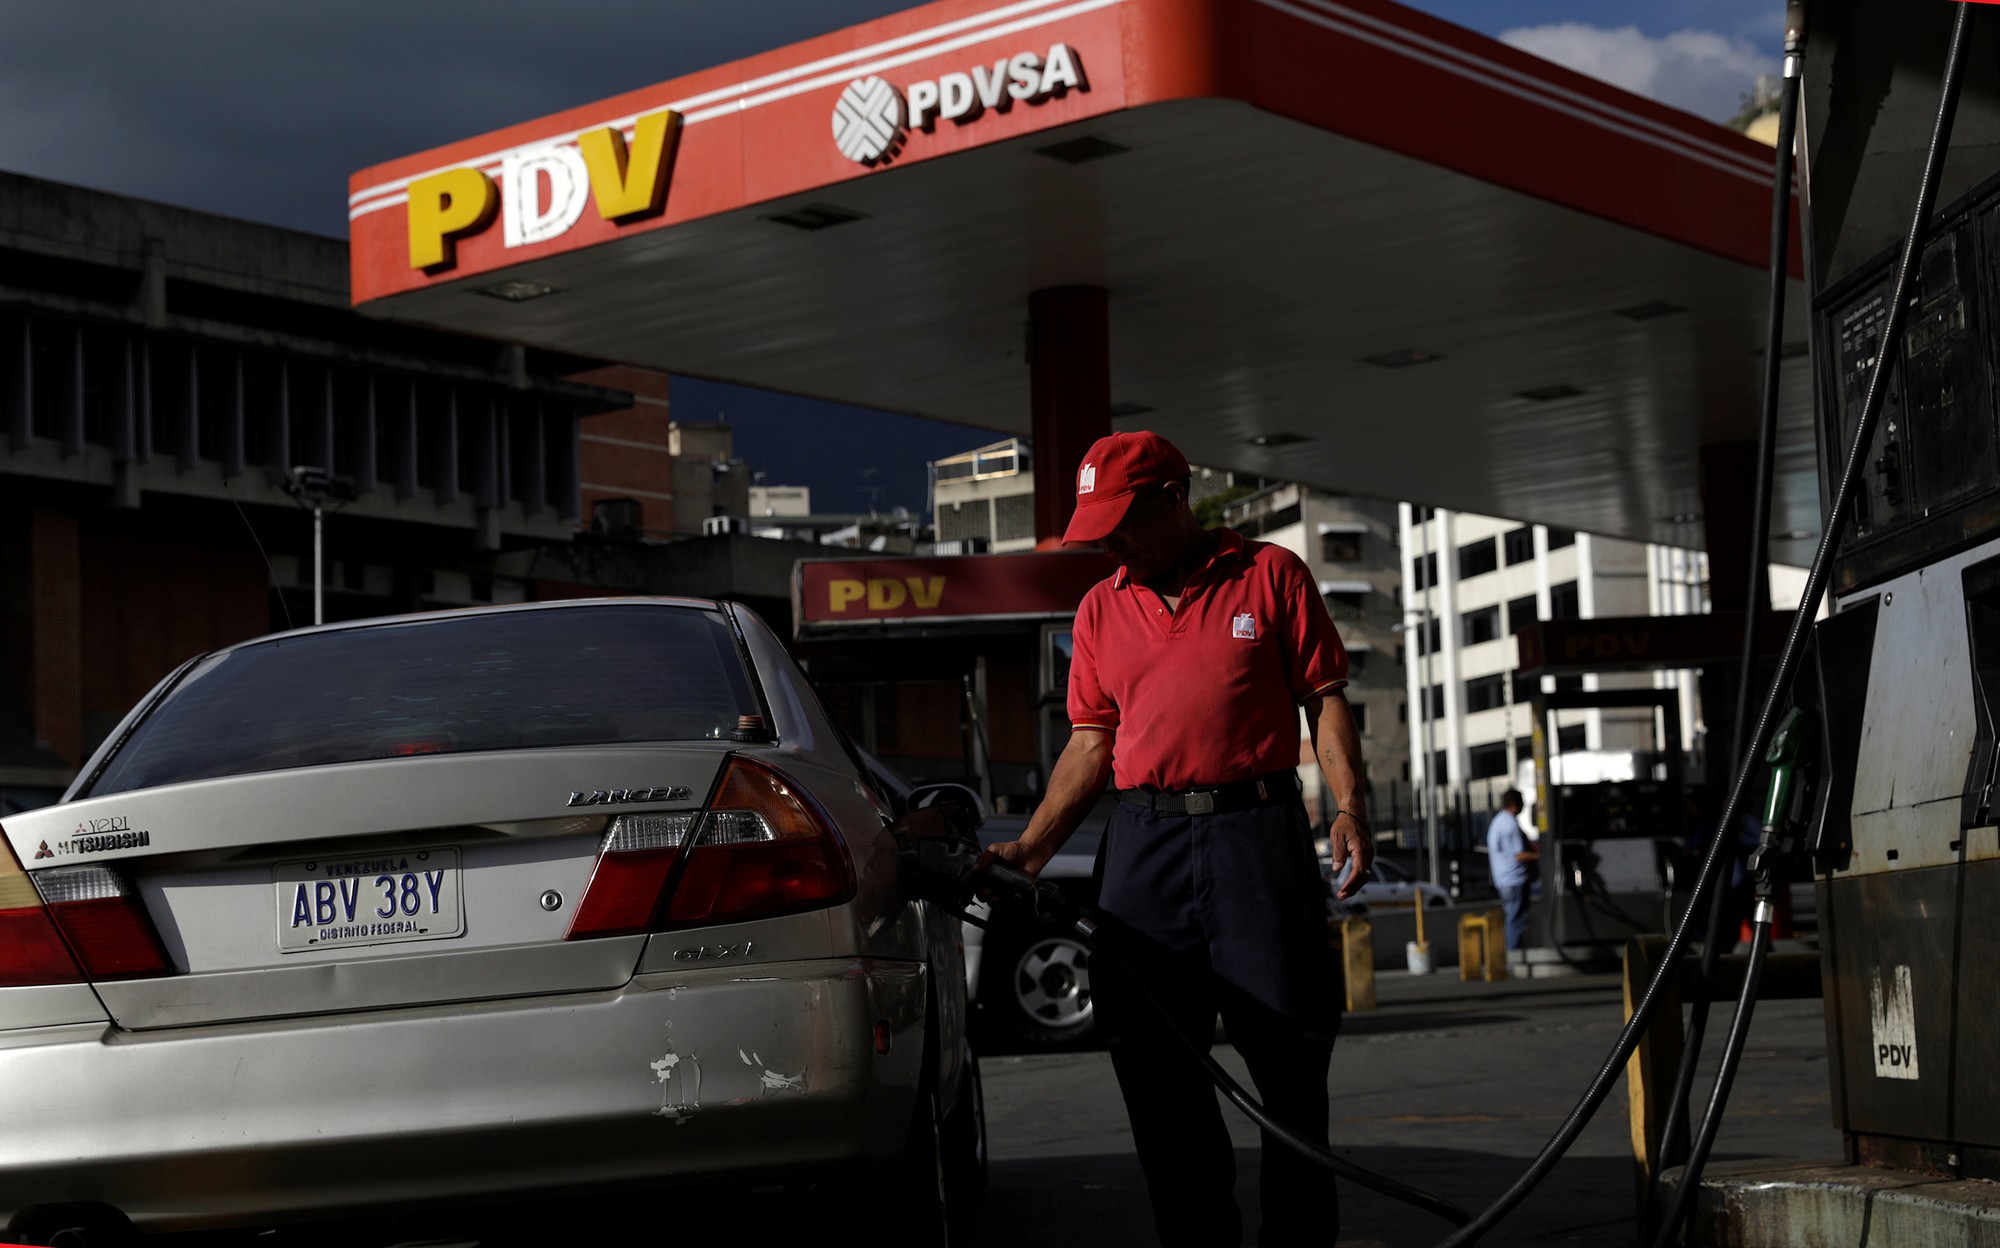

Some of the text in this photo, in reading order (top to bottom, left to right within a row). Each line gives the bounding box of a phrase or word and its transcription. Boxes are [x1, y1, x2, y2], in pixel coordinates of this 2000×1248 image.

[907, 42, 1080, 129] PDVSA
[407, 109, 676, 270] PDV
[829, 576, 946, 612] PDV
[1565, 631, 1651, 659] PDV
[566, 786, 693, 807] LANCER
[325, 859, 409, 877] VENEZUELA
[291, 868, 444, 928] ABV 38Y
[320, 921, 418, 940] DISTRITO FEDERAL
[1879, 1044, 1911, 1068] PDV
